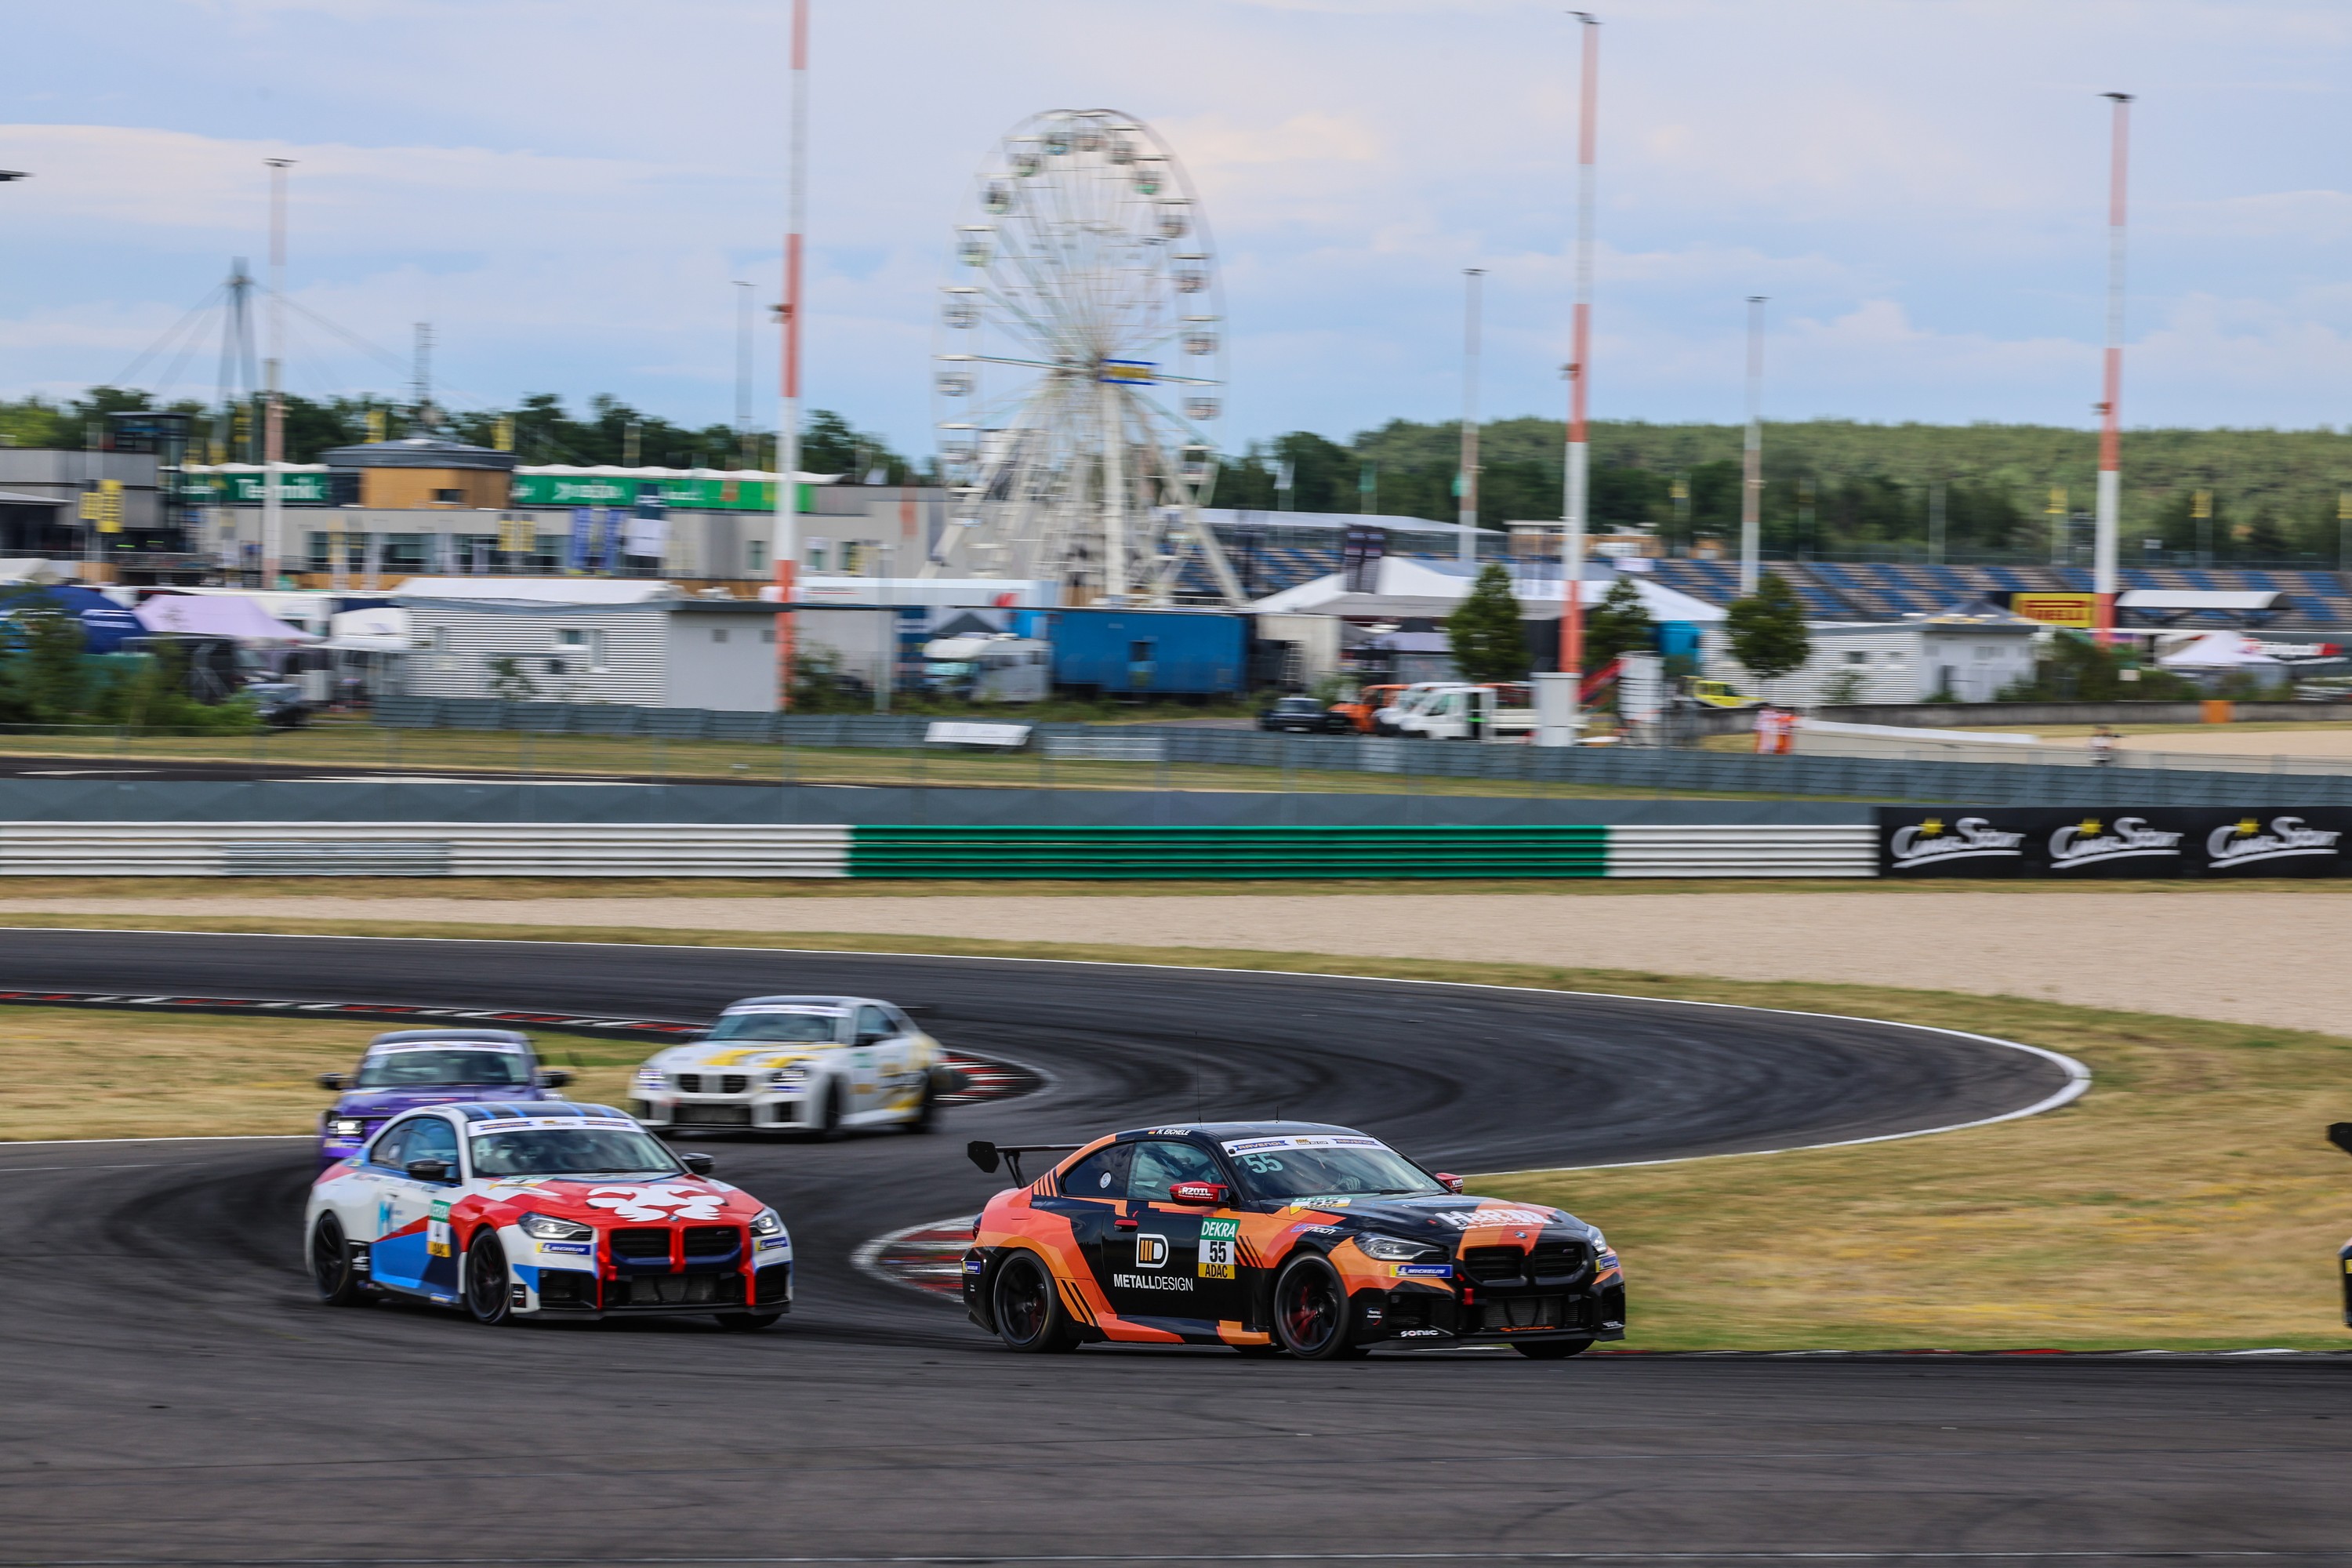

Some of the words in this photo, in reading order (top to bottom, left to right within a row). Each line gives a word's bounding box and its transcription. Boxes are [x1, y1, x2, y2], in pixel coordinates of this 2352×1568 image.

[1237, 1141, 1285, 1150] RAVENOL
[1243, 1152, 1283, 1174] 55
[1201, 1221, 1236, 1238] DEKRA
[1210, 1241, 1227, 1263] 55
[1205, 1265, 1228, 1279] ADAC
[1113, 1273, 1193, 1291] METALLDESIGN
